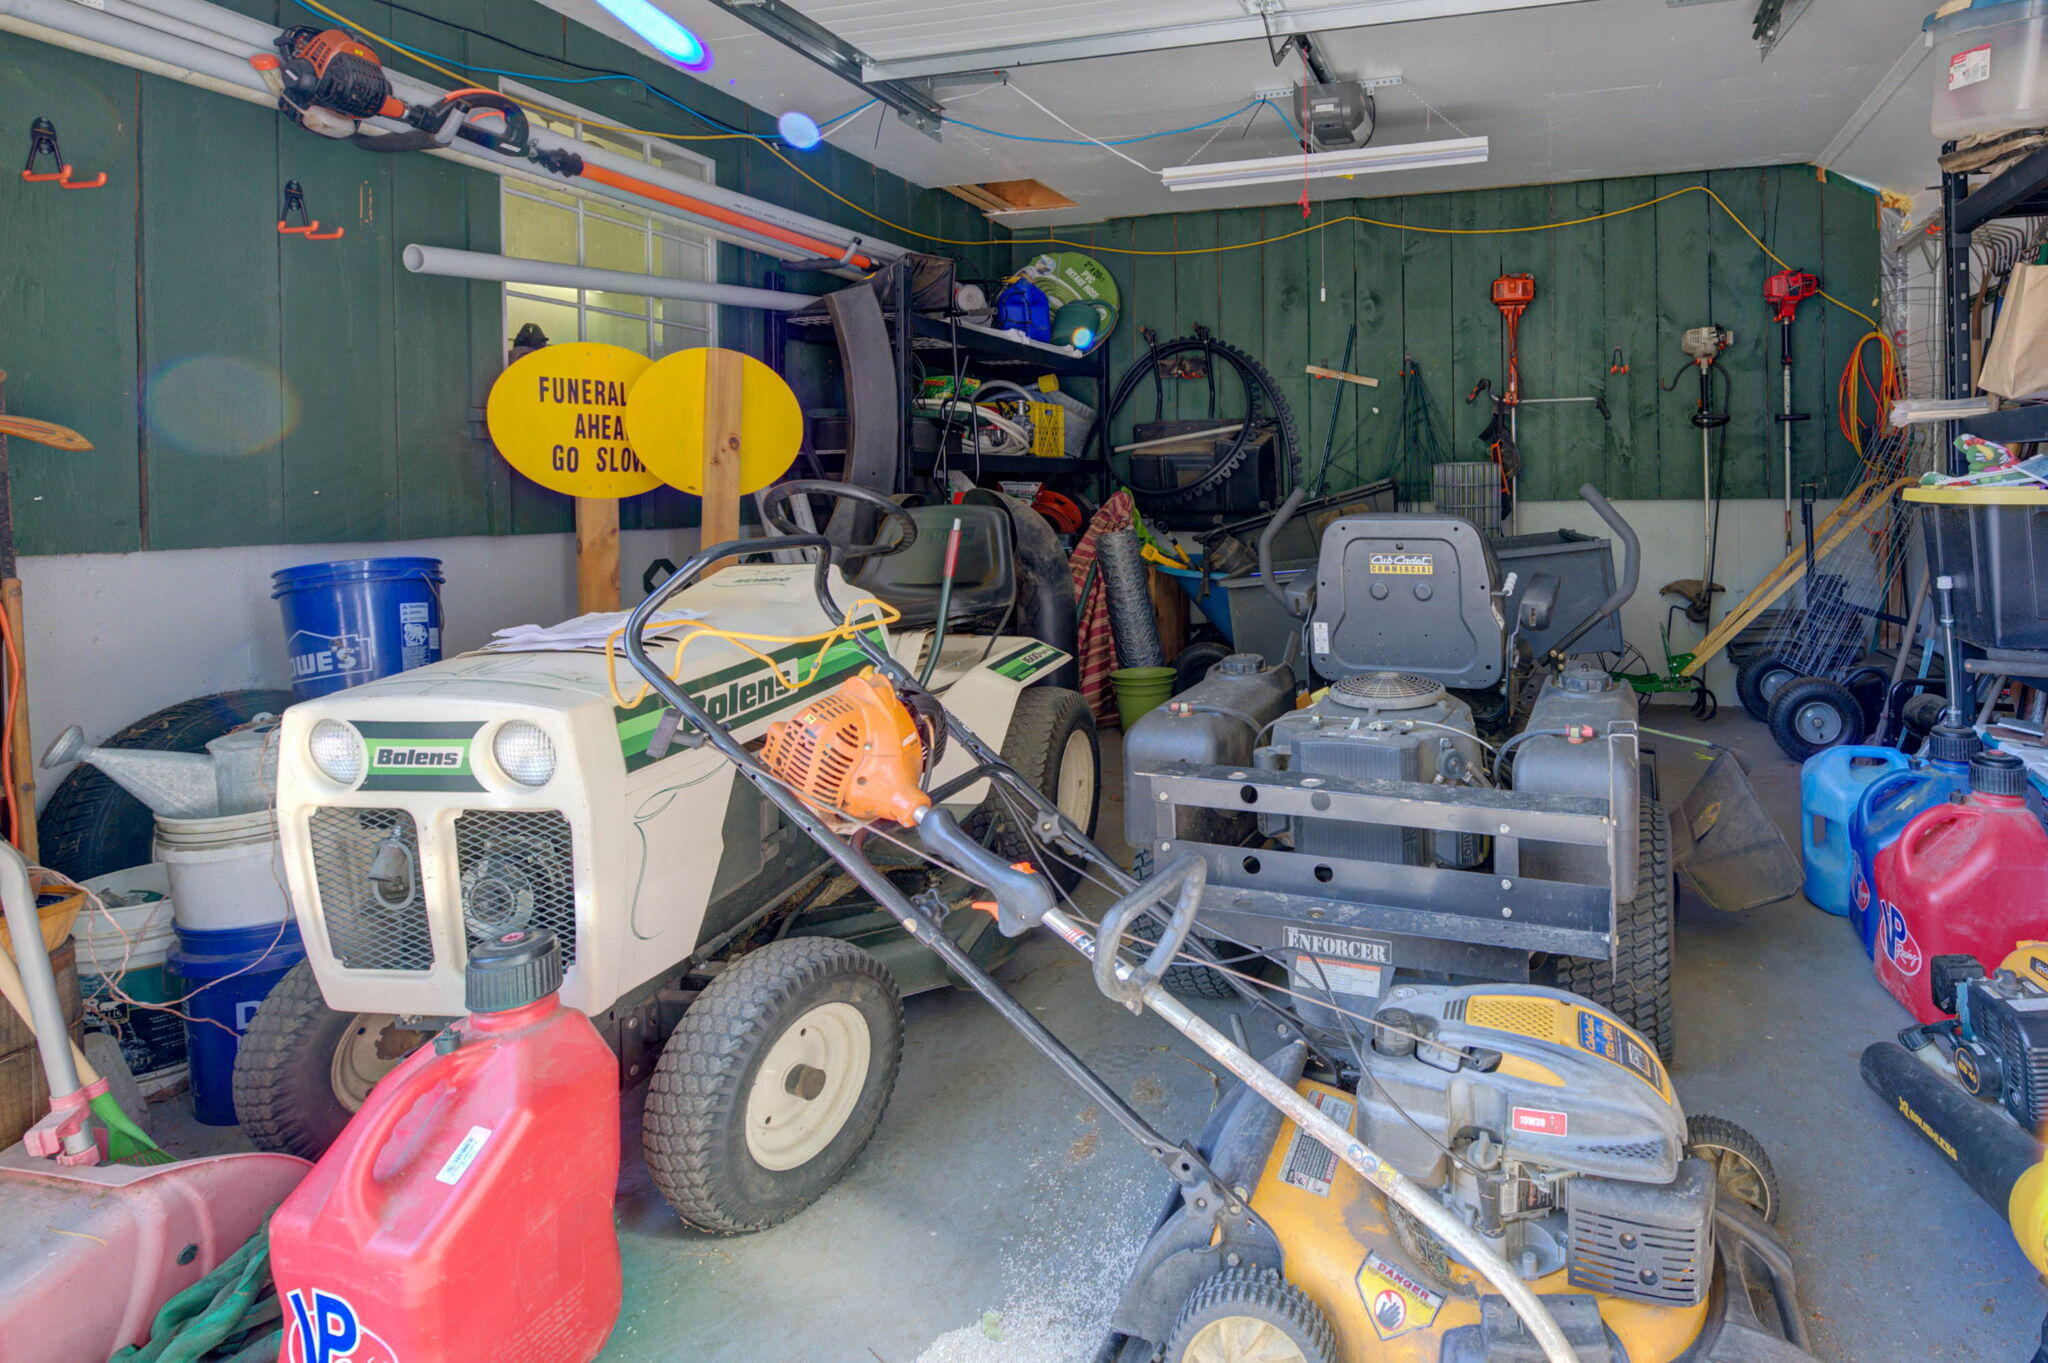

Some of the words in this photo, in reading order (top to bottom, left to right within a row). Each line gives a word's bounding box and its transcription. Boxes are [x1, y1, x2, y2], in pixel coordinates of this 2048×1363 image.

[1081, 270, 1096, 284] PVC
[538, 376, 627, 407] FUNERAL
[574, 413, 630, 441] AHEA
[552, 444, 579, 473] GO
[596, 447, 647, 473] SLOW
[1371, 554, 1393, 565] Cub
[1393, 555, 1431, 566] Cadet
[1371, 565, 1432, 574] COMMERCIAL
[289, 646, 358, 678] OWE'S
[377, 748, 459, 766] Bolens
[1880, 898, 1908, 962] VP
[1287, 929, 1387, 963] ENFORCER
[1909, 1108, 1958, 1161] BRUSHLESS
[1378, 1262, 1430, 1300] DANGER
[286, 1287, 361, 1363] VP
